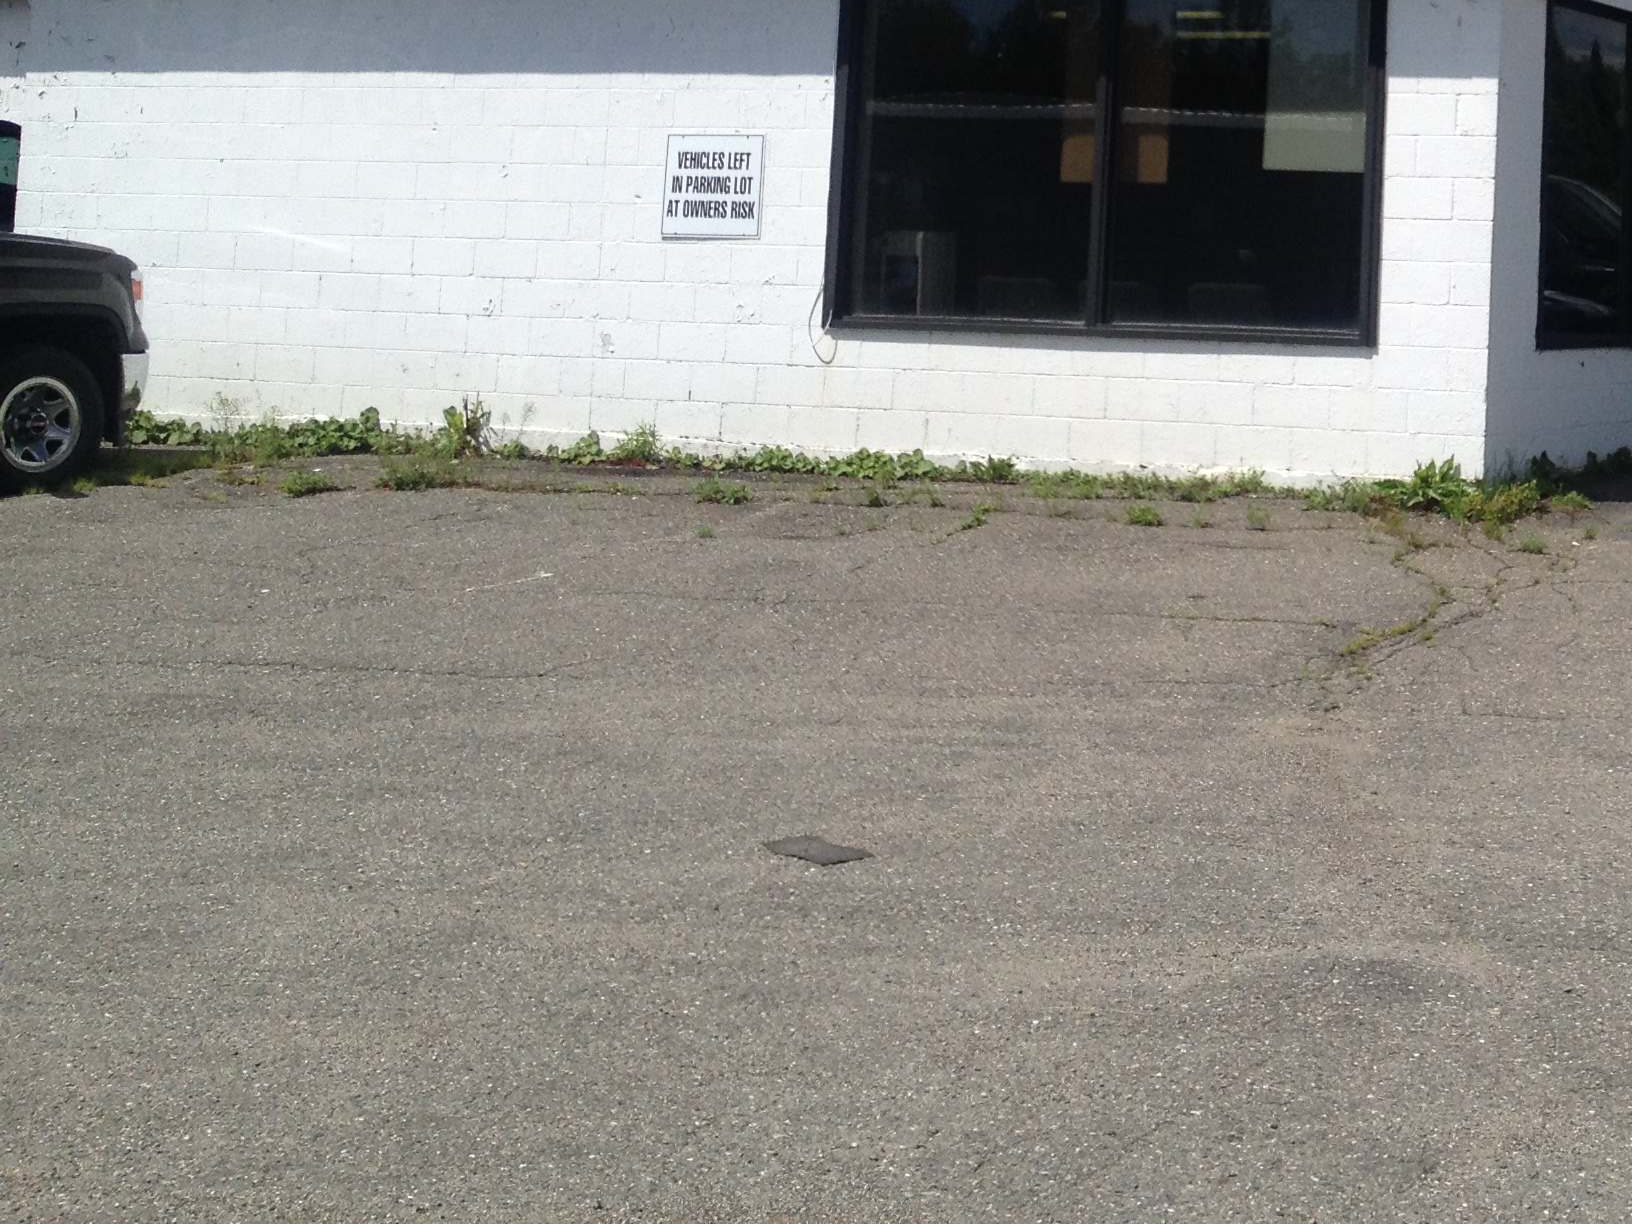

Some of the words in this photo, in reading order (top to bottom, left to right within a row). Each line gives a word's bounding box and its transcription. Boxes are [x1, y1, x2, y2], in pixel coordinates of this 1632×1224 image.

[677, 151, 725, 170] VEHICLES
[727, 152, 752, 171] LEFT
[671, 175, 683, 194] IN
[685, 175, 731, 195] PARKING
[733, 176, 754, 195] LOT
[666, 199, 680, 218] AT
[682, 200, 728, 219] OWNERS
[730, 201, 756, 220] RISK
